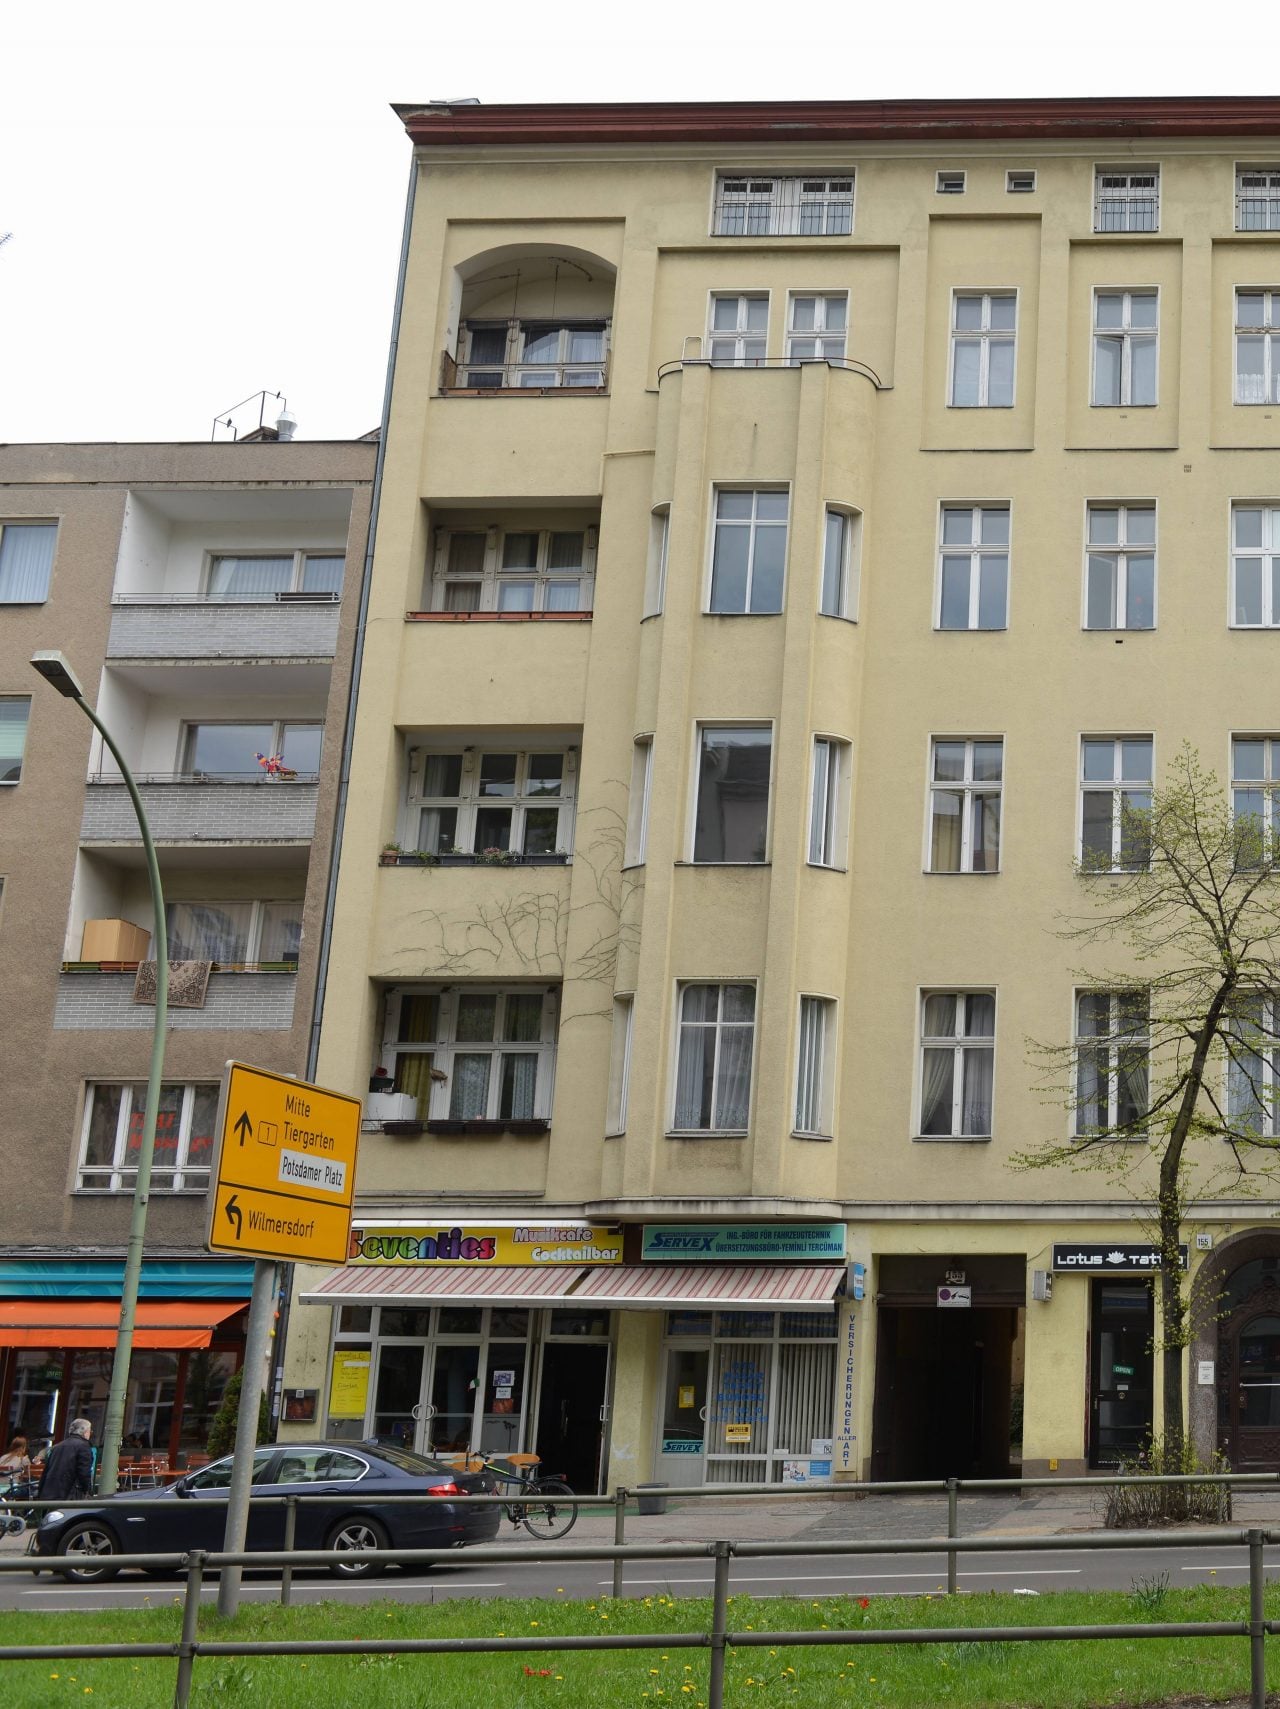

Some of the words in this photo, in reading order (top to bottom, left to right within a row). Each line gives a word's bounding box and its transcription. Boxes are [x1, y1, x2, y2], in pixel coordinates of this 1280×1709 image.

[285, 1094, 311, 1118] Mitte
[284, 1121, 335, 1151] Tiergarten
[282, 1156, 322, 1181] Potsdamer
[325, 1168, 343, 1187] Platz
[249, 1209, 314, 1239] Wilmersdorf
[726, 1229, 759, 1240] ING.-BÜRO
[760, 1229, 772, 1240] FÜR
[773, 1230, 831, 1240] FAHRZEUGTECHNIK
[349, 1227, 496, 1260] Seventies
[531, 1246, 619, 1262] Cocktailbar
[808, 1241, 843, 1252] TERCÜMAN
[1198, 1238, 1209, 1246] 155
[843, 1314, 856, 1435] VERSICHERUNGEN
[1115, 1366, 1131, 1374] OPEN
[664, 1441, 704, 1453] SERVEX
[842, 1442, 850, 1467] ART
